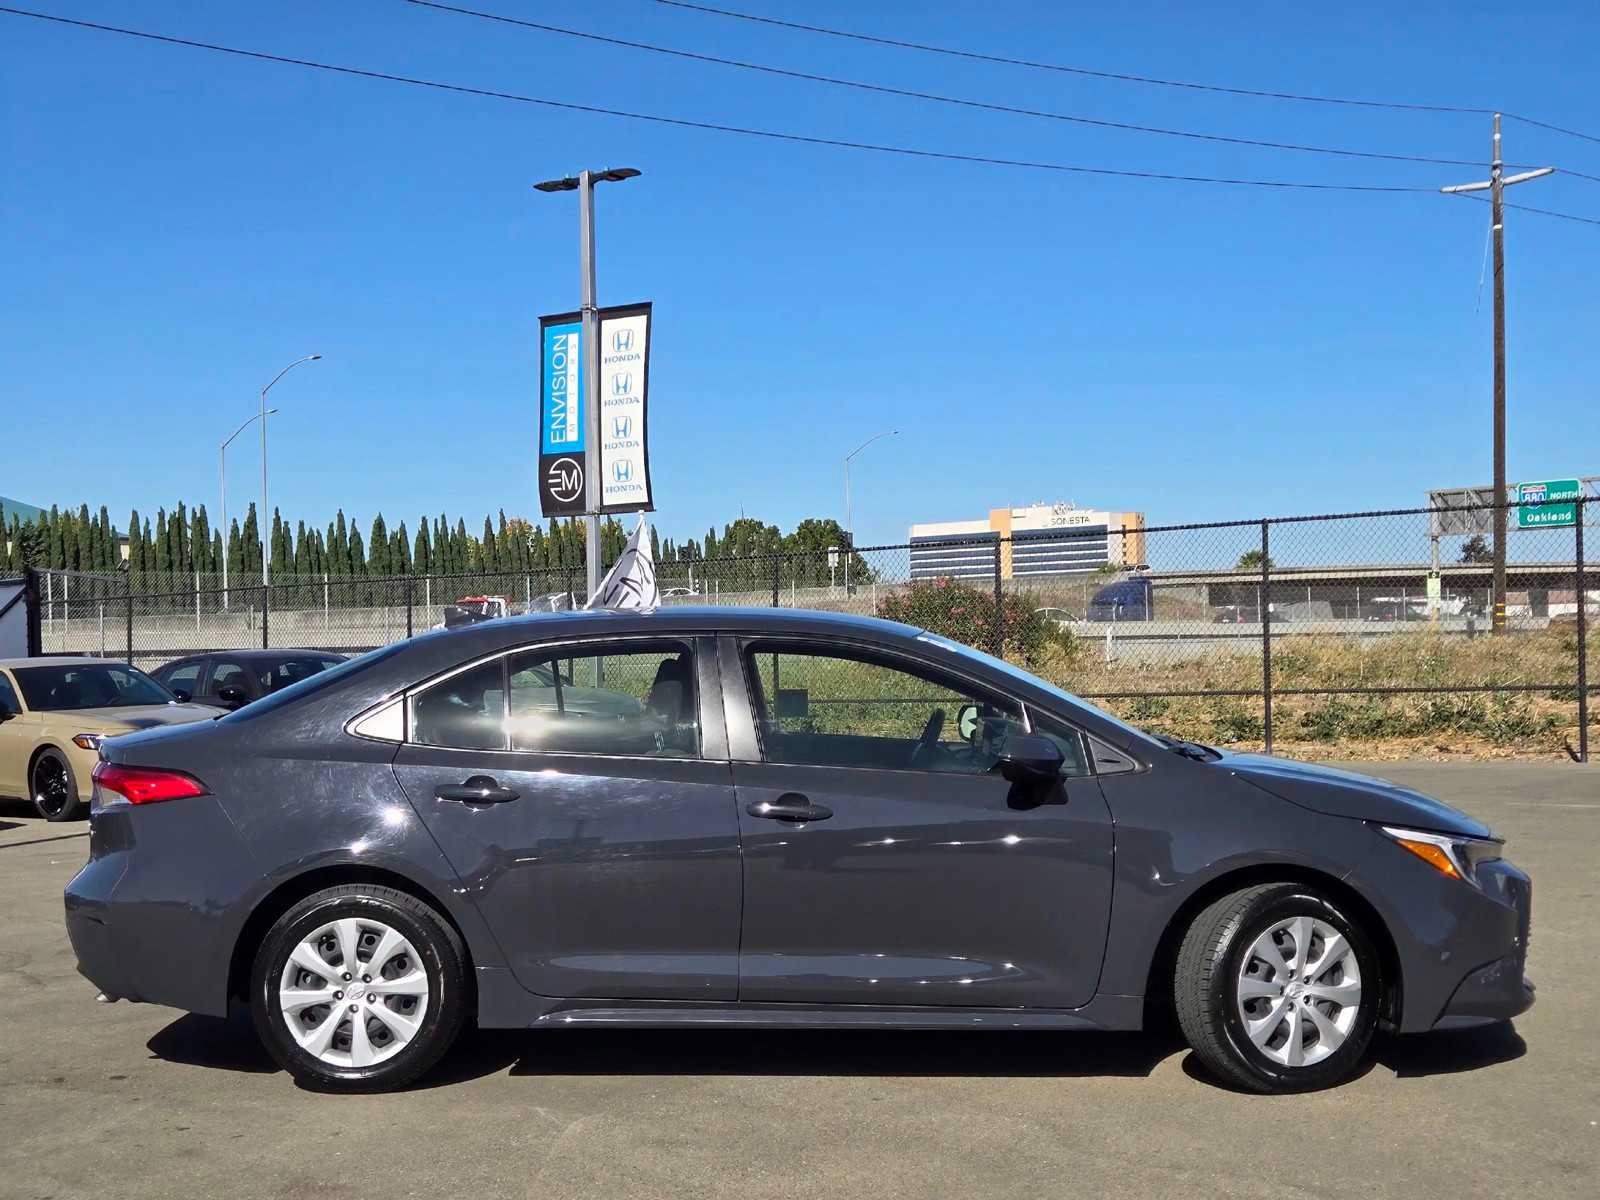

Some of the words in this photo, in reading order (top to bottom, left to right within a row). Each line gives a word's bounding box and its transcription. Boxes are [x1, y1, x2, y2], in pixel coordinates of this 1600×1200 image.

[604, 353, 641, 364] HONDA
[551, 334, 568, 443] ENVISION
[604, 396, 640, 407] HONDA
[604, 440, 640, 450] HONDA
[605, 484, 643, 494] HONDA
[1549, 490, 1578, 500] NORTH
[1050, 516, 1090, 526] SONESTA
[1527, 511, 1572, 522] Oakland
